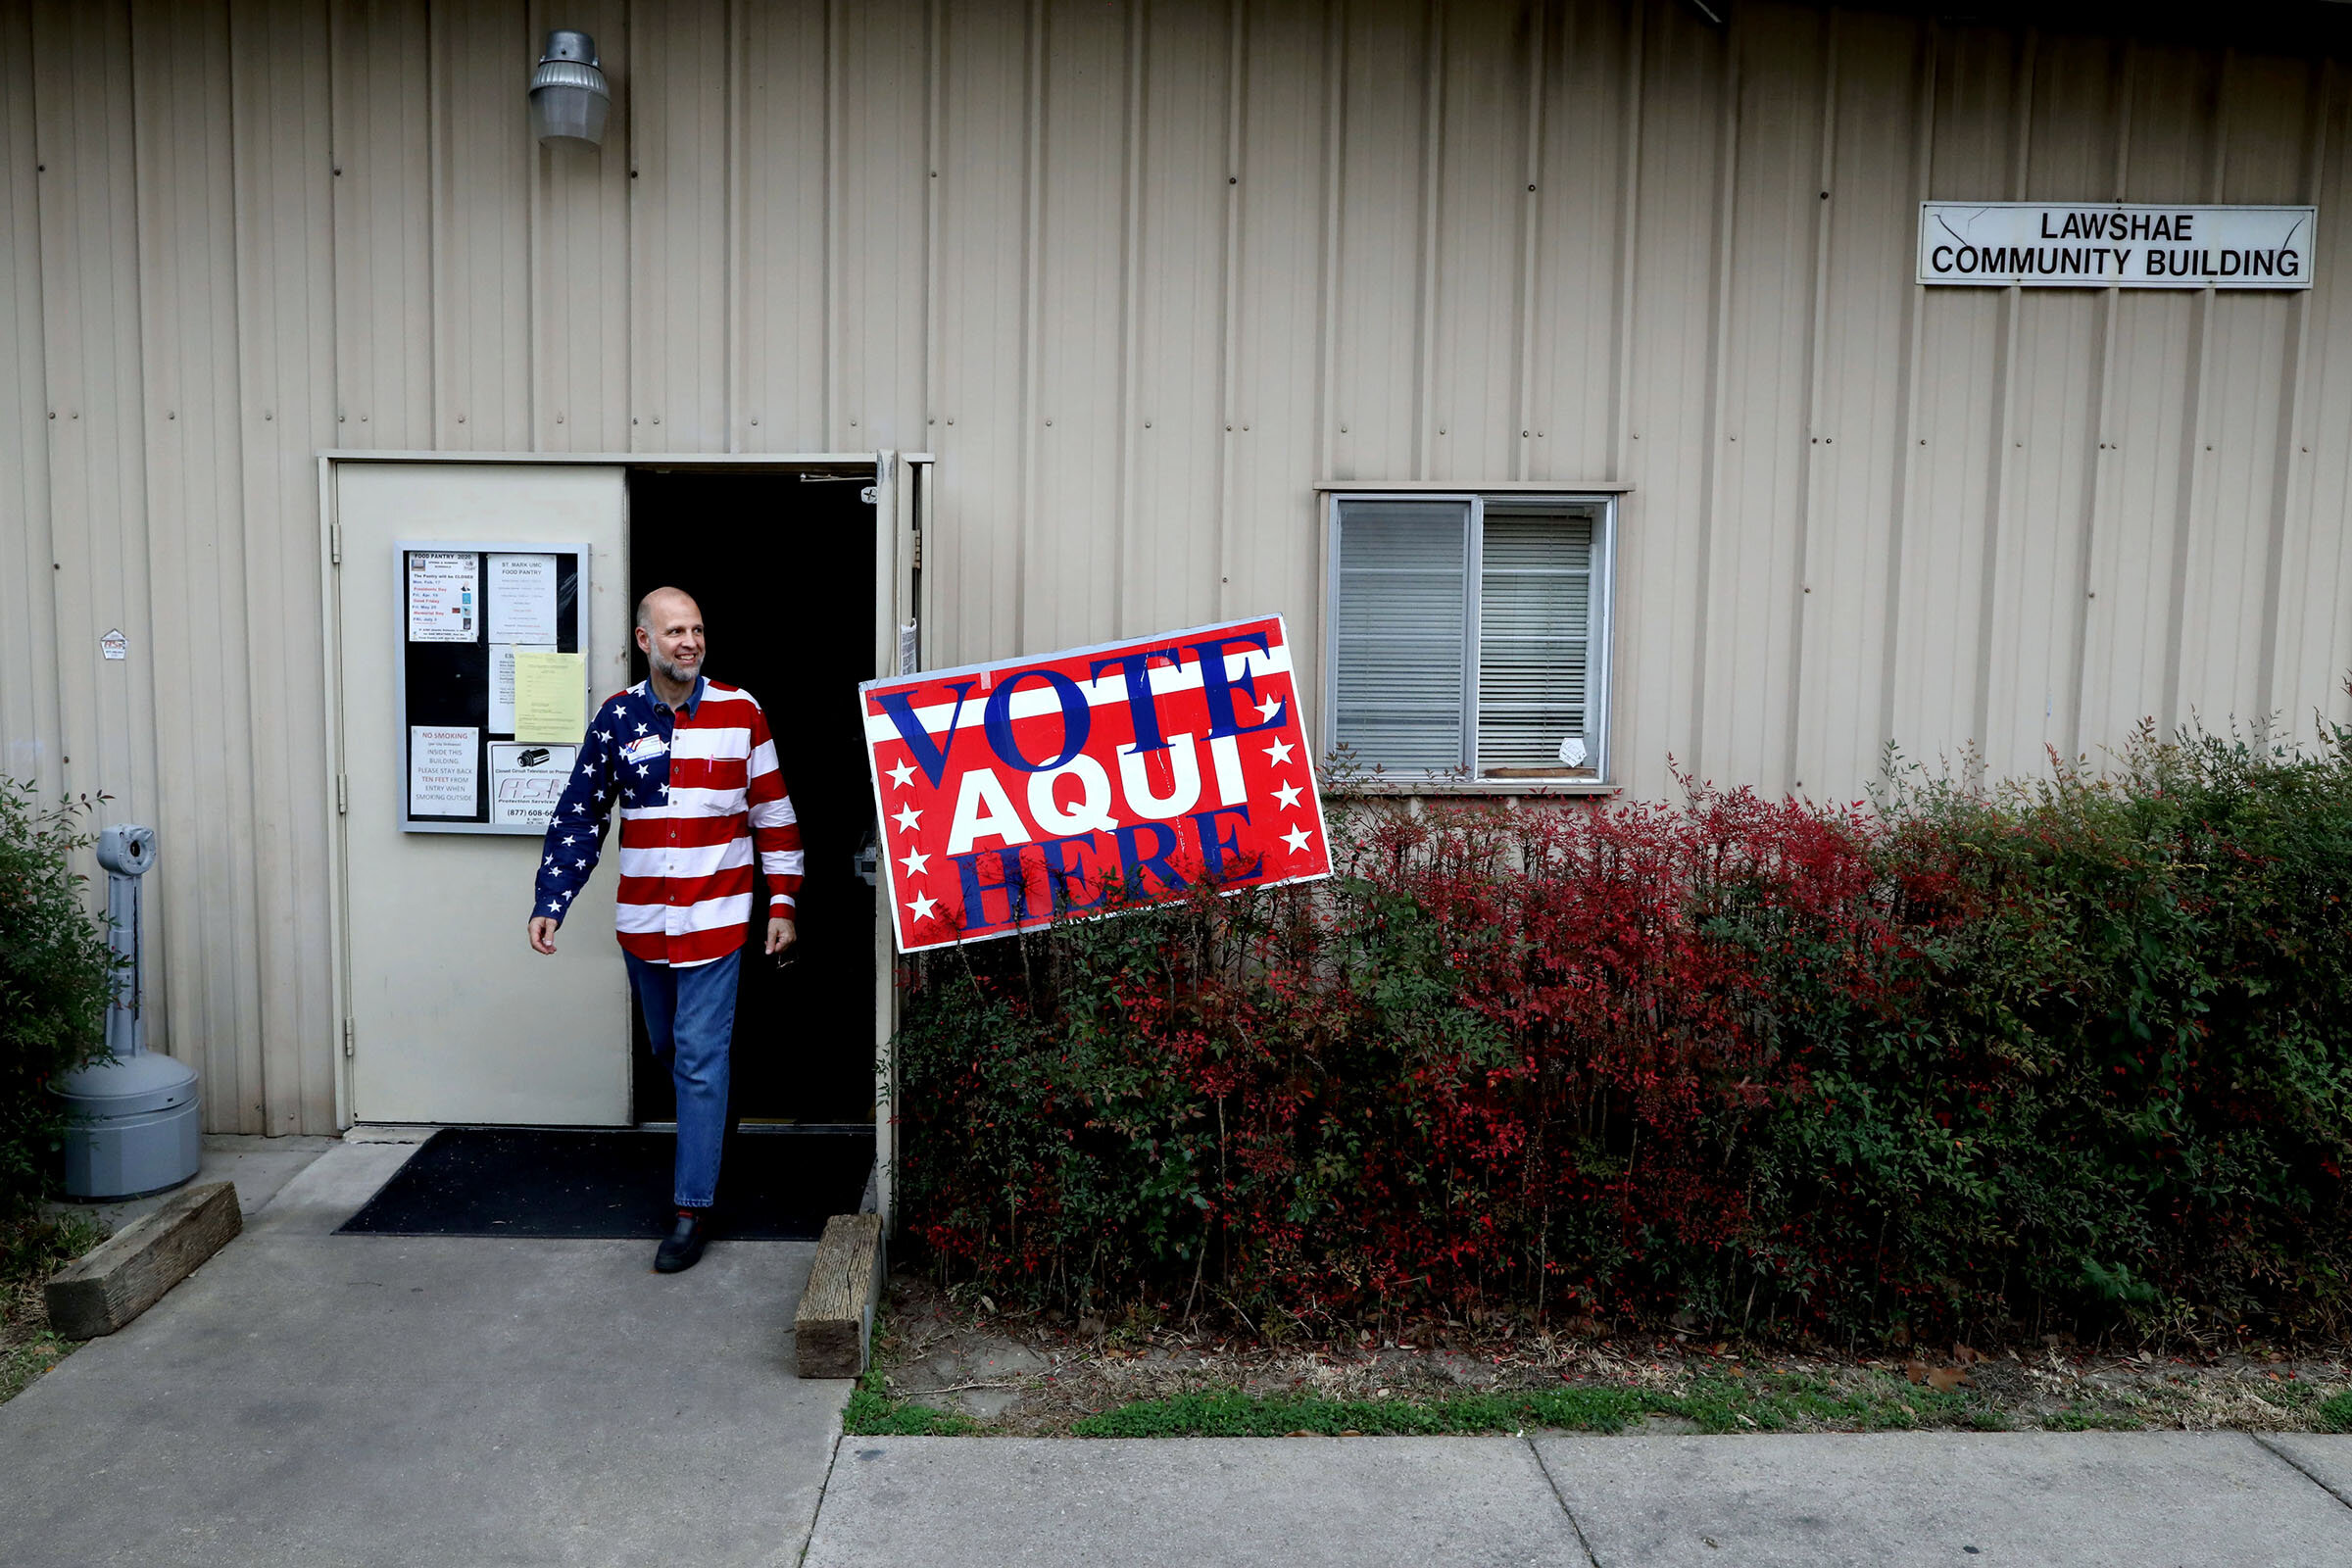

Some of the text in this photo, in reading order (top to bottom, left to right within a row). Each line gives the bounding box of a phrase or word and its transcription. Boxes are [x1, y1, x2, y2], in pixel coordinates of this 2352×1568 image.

[1932, 245, 2299, 277] COMMUNITY BUILDING
[2040, 213, 2193, 241] LAWSHAE
[869, 631, 1288, 791] VOTE
[507, 808, 555, 817] (877) 608-66
[945, 728, 1249, 856] AQUI
[947, 805, 1263, 930] HERE
